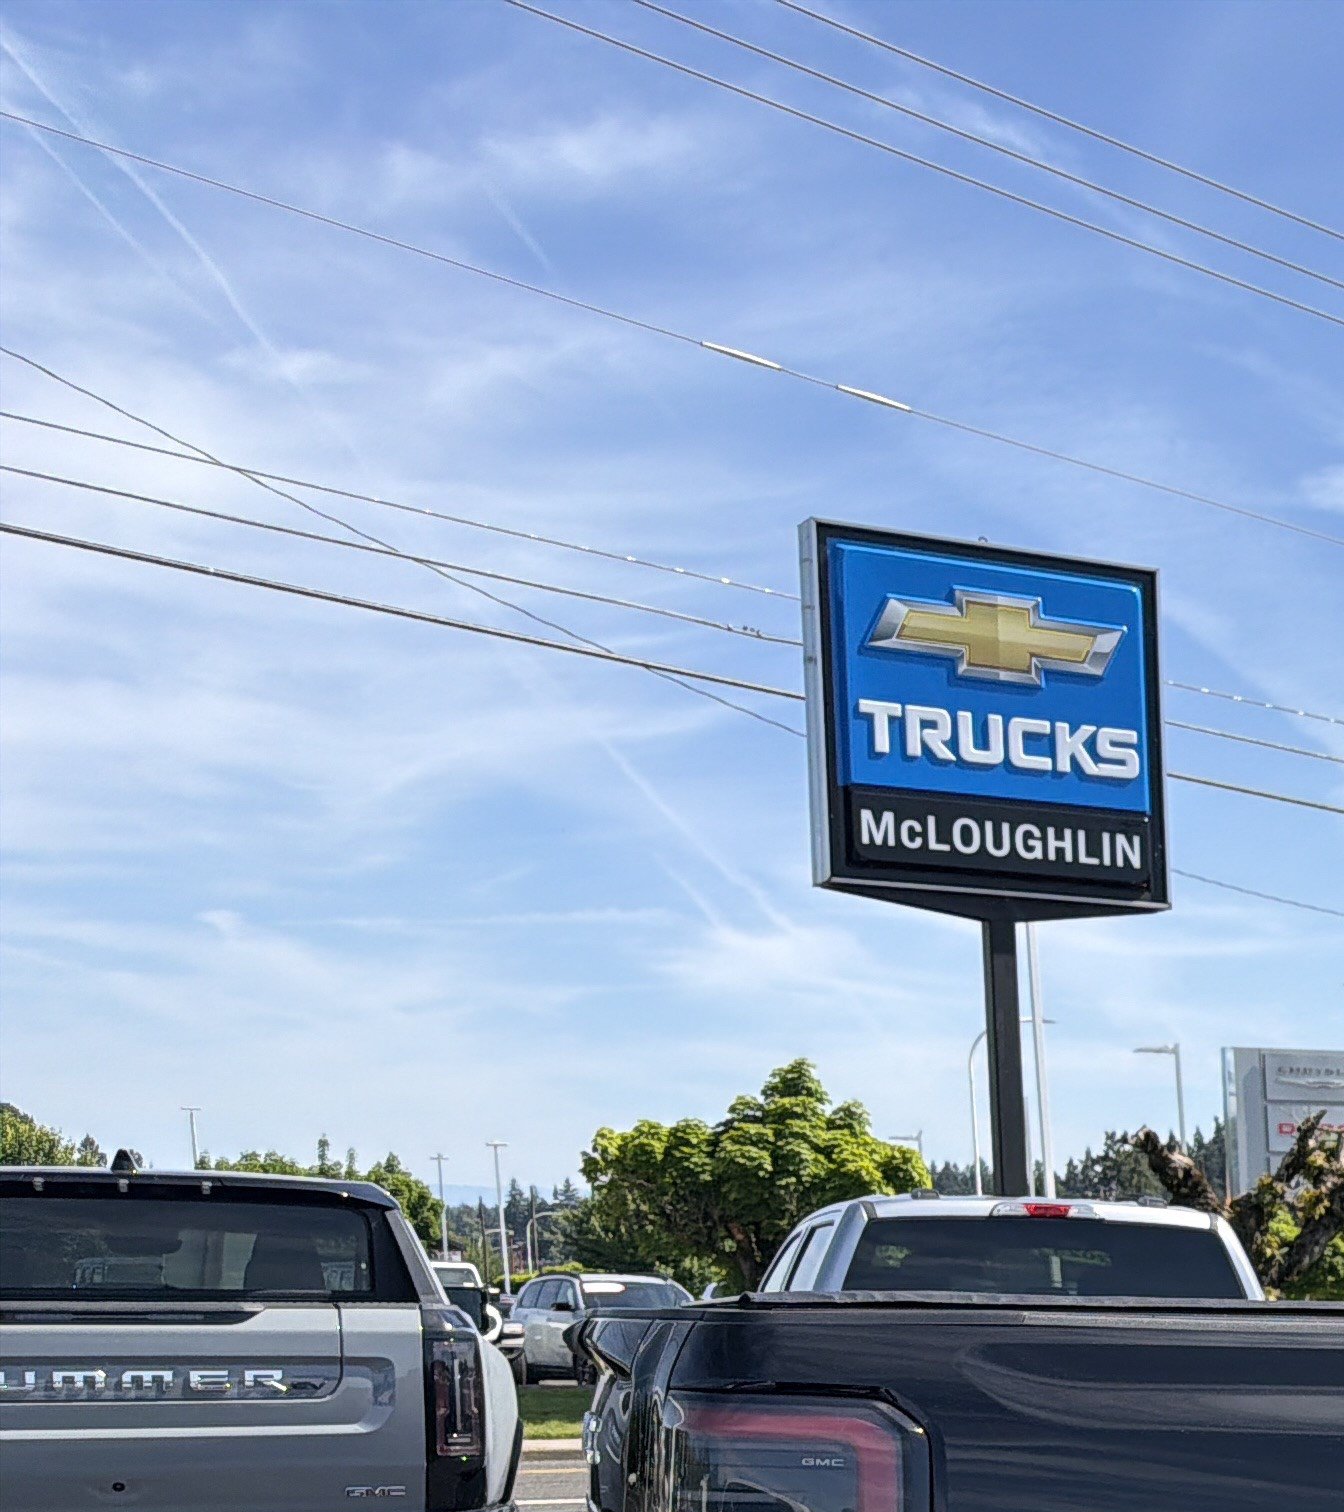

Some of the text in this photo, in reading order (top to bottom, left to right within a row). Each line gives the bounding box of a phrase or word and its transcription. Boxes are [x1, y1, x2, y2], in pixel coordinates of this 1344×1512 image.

[858, 699, 1139, 779] TRUCKS
[860, 809, 1141, 869] McLOUGHLIN
[802, 1457, 845, 1467] GMC
[345, 1485, 406, 1498] GMC
